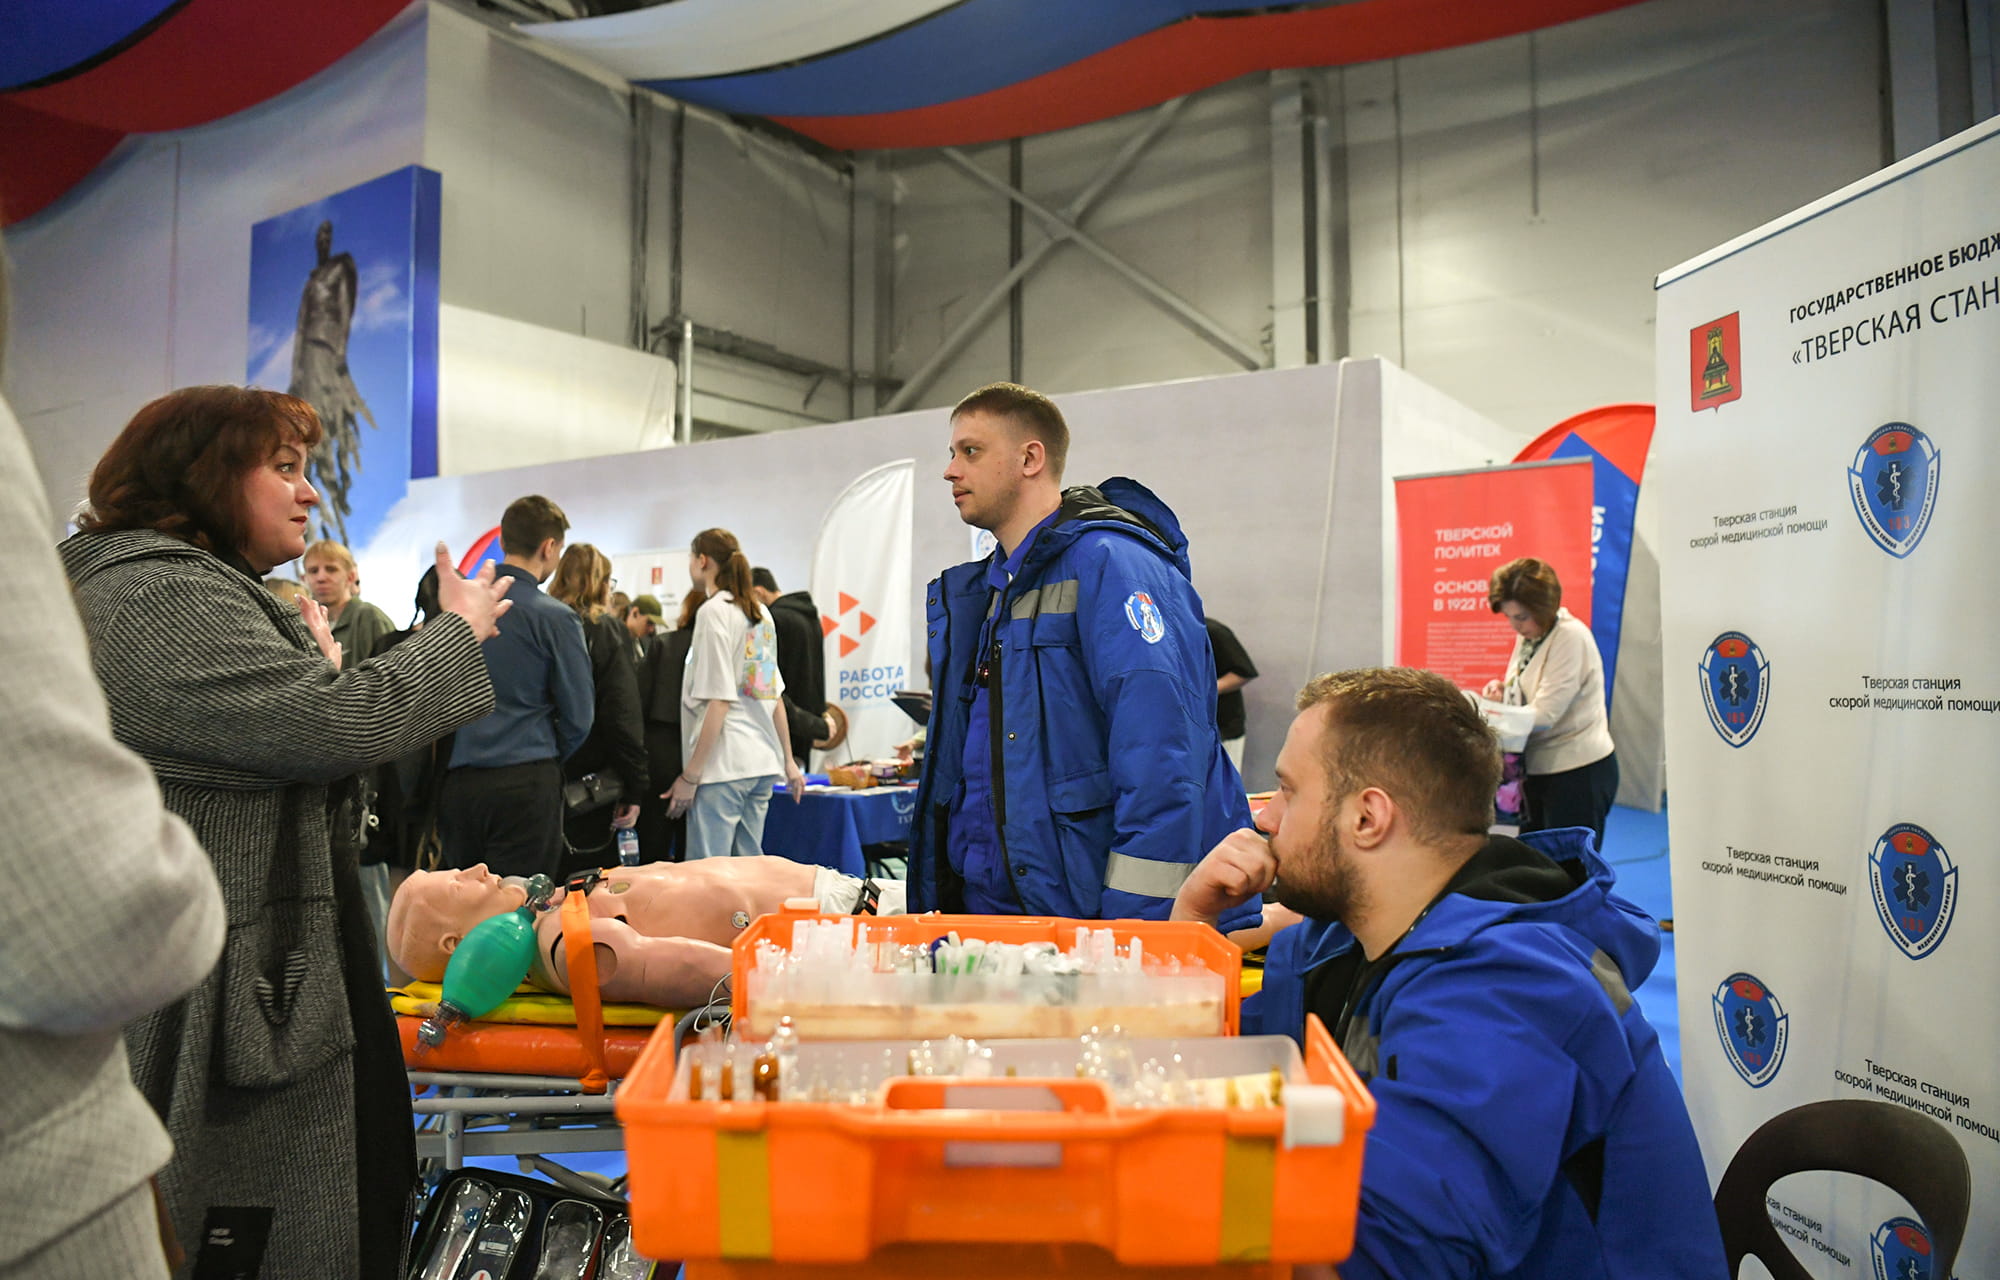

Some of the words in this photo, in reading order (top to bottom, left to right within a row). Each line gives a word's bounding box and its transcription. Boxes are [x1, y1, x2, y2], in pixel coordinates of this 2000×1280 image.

[1790, 254, 1945, 323] ГОСУДАРСТВЕННОЕ
[1791, 303, 1922, 364] «ТВЕРСКАЯ
[1929, 276, 2000, 323] СТАН
[1712, 512, 1757, 529] Тверская
[1759, 505, 1798, 521] станция
[1435, 522, 1513, 542] ТВЕРСКОЙ
[1690, 532, 1719, 549] скорой
[1721, 523, 1784, 544] медицинской
[1786, 517, 1829, 534] помощи
[1434, 544, 1501, 559] ПОЛИТЕХ
[1433, 579, 1489, 594] ОСНОВ
[1433, 597, 1444, 611] В
[1447, 597, 1477, 611] 1922
[840, 665, 904, 684] РАБОТА
[1861, 675, 1909, 693] Тверская
[1911, 678, 1961, 692] станция
[1829, 694, 1871, 711] скорой
[1873, 695, 1943, 711] медицинской
[1725, 845, 1772, 865] Тверская
[1774, 855, 1820, 872] станция
[1701, 858, 1735, 876] скорой
[1736, 867, 1805, 887] медицинской
[1807, 878, 1848, 896] помощи
[1865, 1058, 1918, 1089] Тверская
[1920, 1081, 1970, 1110] станция
[1834, 1069, 1873, 1092] скорой
[1875, 1084, 1952, 1122] медицинской
[1956, 1115, 2000, 1144] помощ
[1782, 1206, 1823, 1233] станция
[1811, 1238, 1851, 1267] помощи
